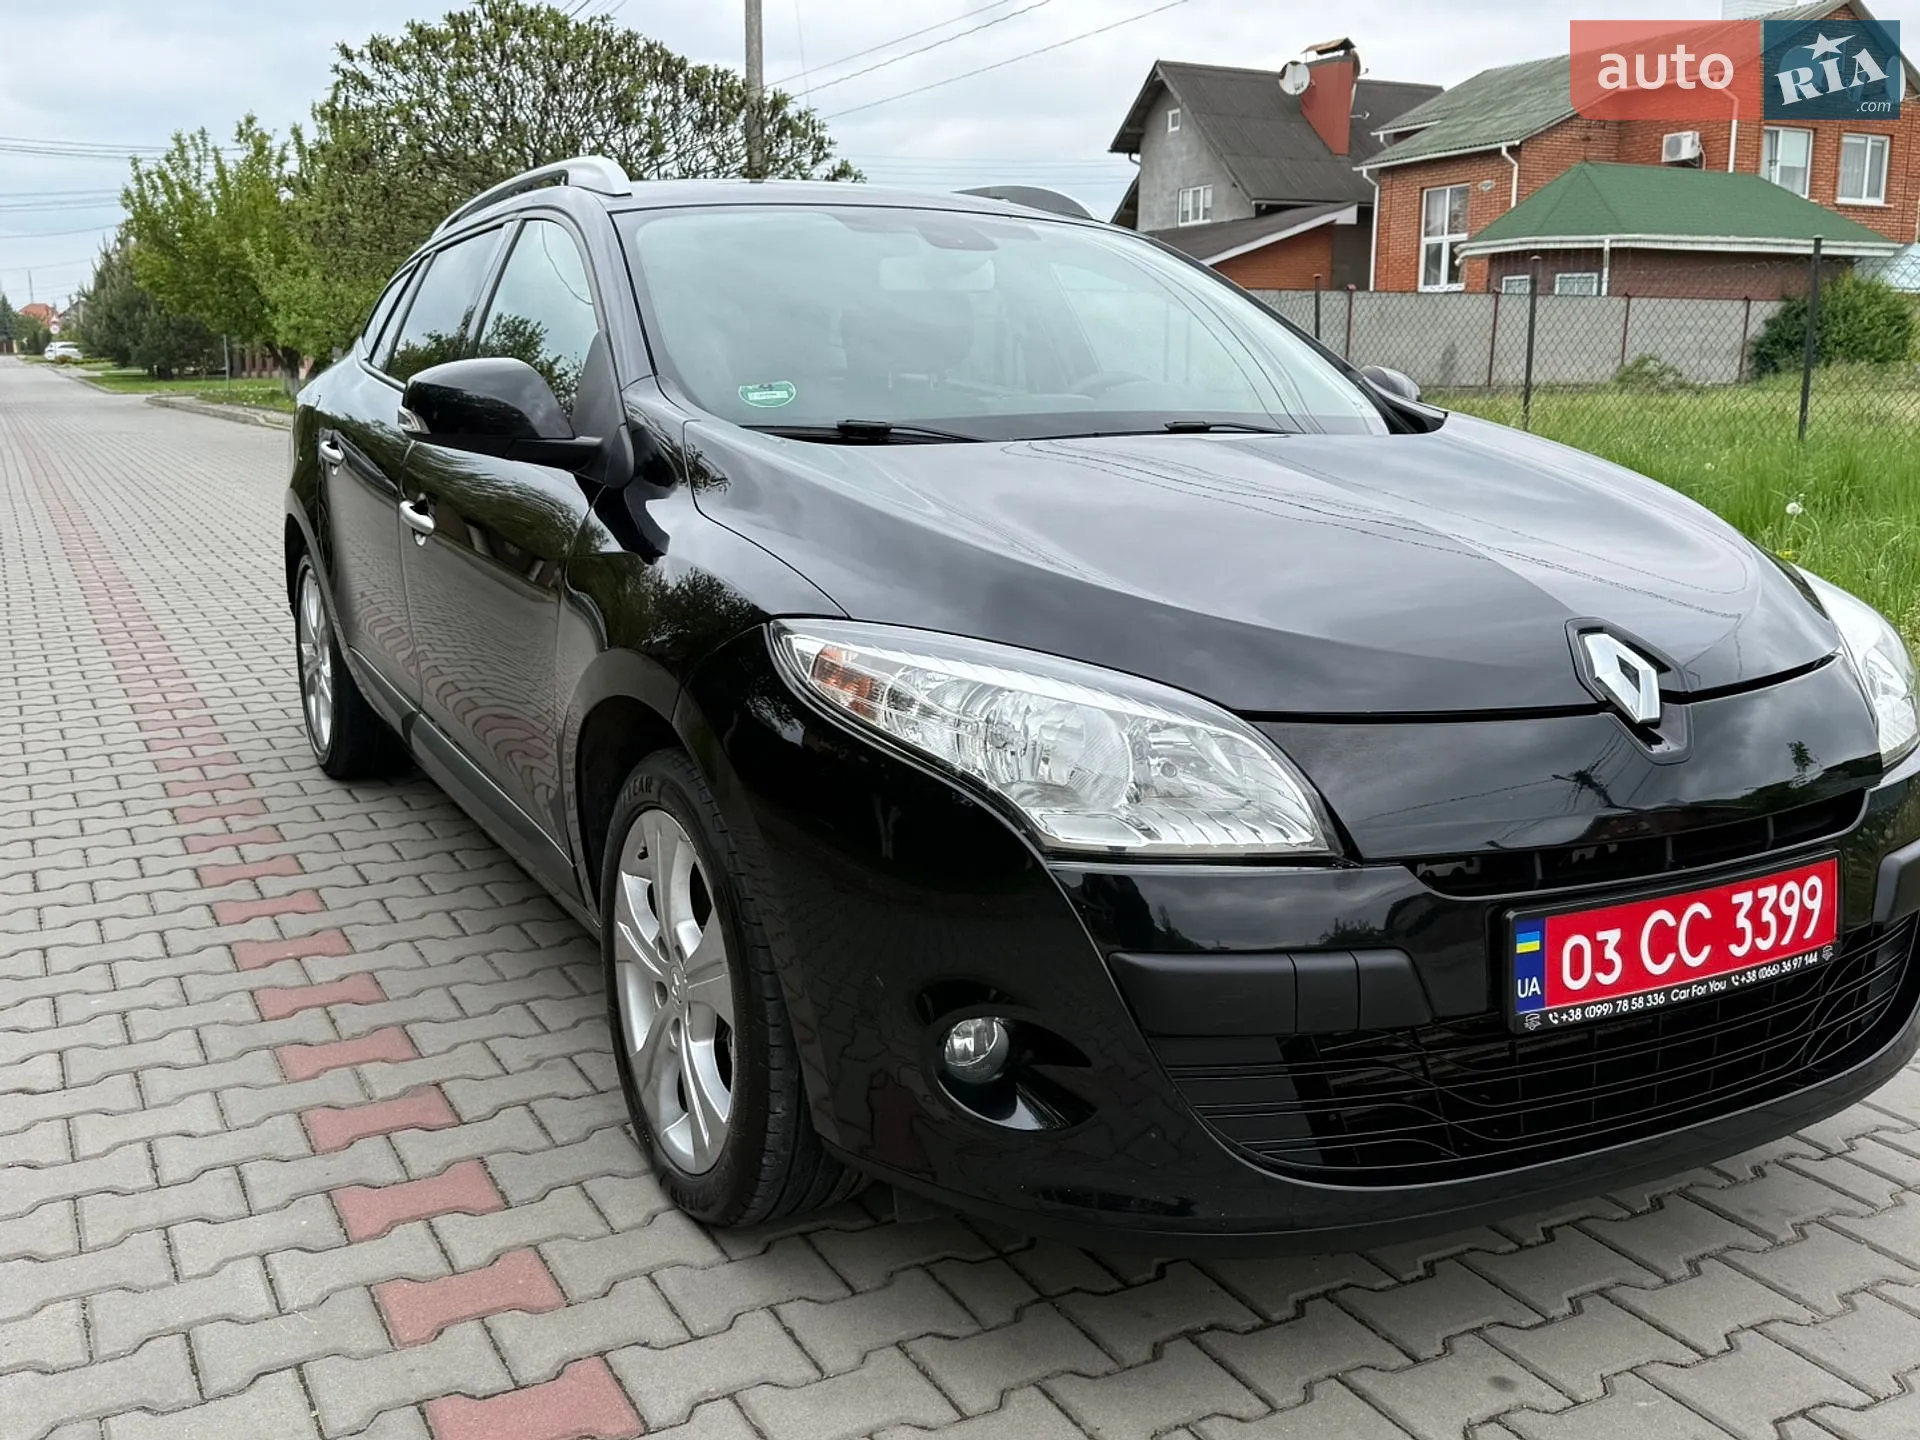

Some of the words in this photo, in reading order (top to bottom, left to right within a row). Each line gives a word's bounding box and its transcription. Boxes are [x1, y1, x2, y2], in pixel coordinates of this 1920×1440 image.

[1562, 928, 1622, 990] 03
[1640, 902, 1712, 975] CC
[1728, 875, 1822, 957] 3399
[1517, 977, 1541, 998] UA
[1561, 1008, 1582, 1022] +38
[1584, 1003, 1613, 1018] (099)
[1616, 1000, 1629, 1013] 78
[1631, 996, 1644, 1010] 58
[1646, 992, 1665, 1007] 336
[1671, 989, 1689, 1001] Car
[1691, 984, 1707, 997] For
[1709, 979, 1727, 993] You
[1792, 956, 1803, 970] 97
[1804, 951, 1818, 965] 144
